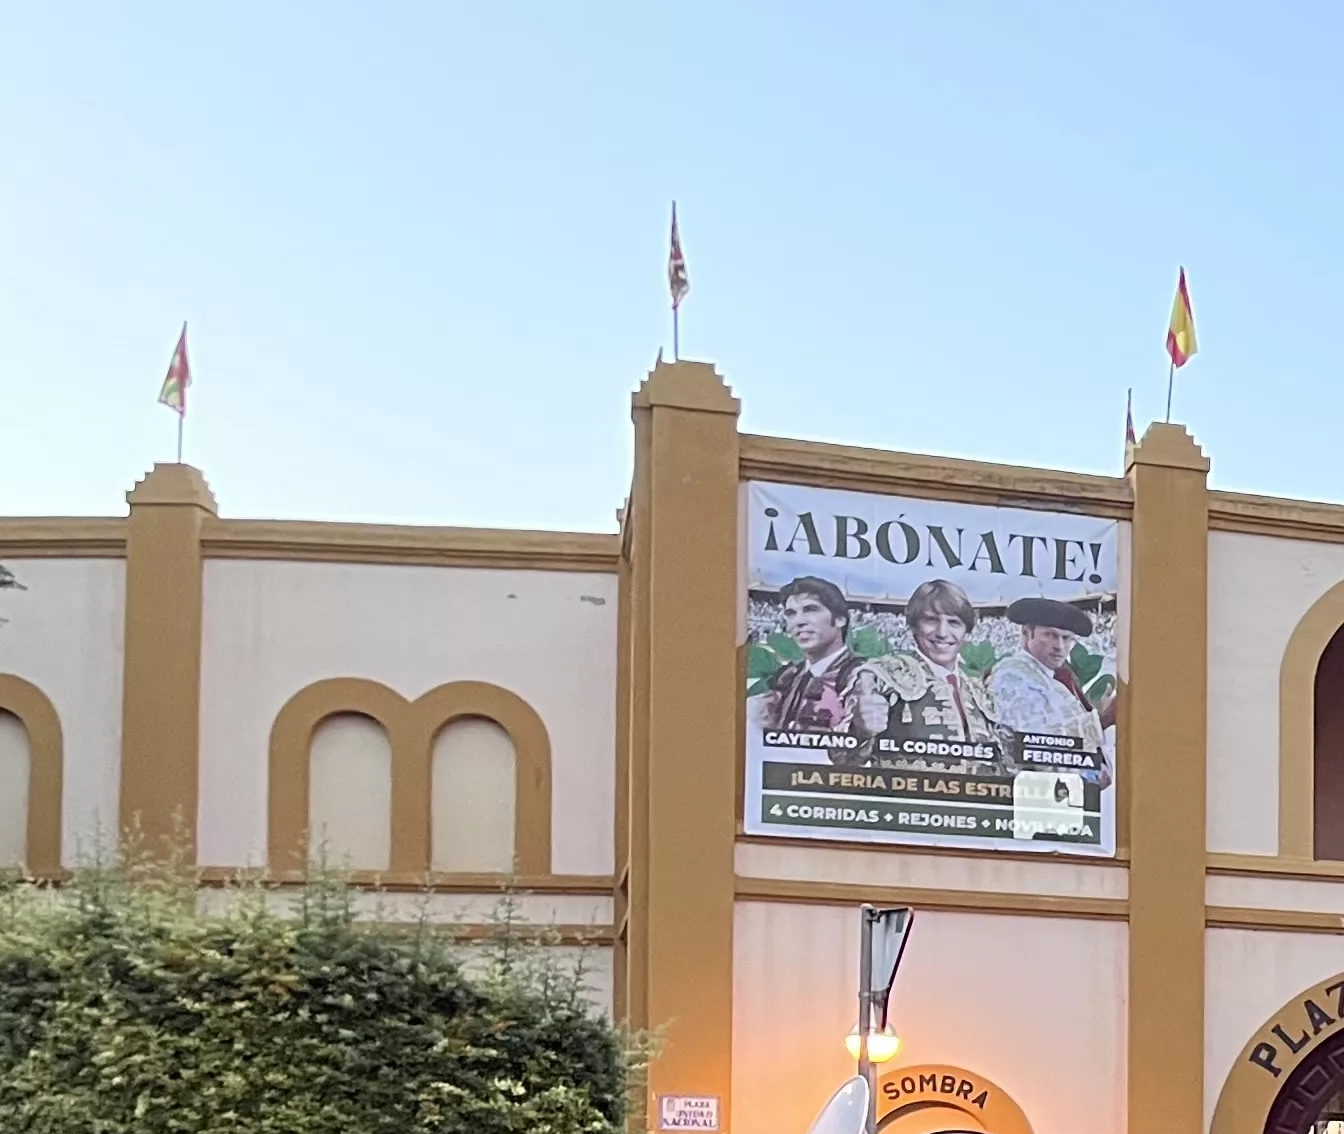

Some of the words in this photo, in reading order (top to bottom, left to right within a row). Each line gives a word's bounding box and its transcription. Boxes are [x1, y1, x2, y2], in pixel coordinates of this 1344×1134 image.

[763, 508, 1103, 584] ¡ABÓNATE!
[765, 732, 858, 748] CAYETANO
[879, 739, 900, 751] EL
[903, 741, 994, 759] CORDOBÉS
[1023, 735, 1075, 747] ANTONIO
[1023, 750, 1095, 767] FERRERA
[828, 773, 887, 790] FERIA
[891, 777, 918, 791] DE
[923, 779, 960, 794] LAS
[770, 804, 783, 817] 4
[786, 805, 880, 823] CORRIDAS
[899, 812, 977, 828] REJONES
[883, 1073, 989, 1110] SOMBRA
